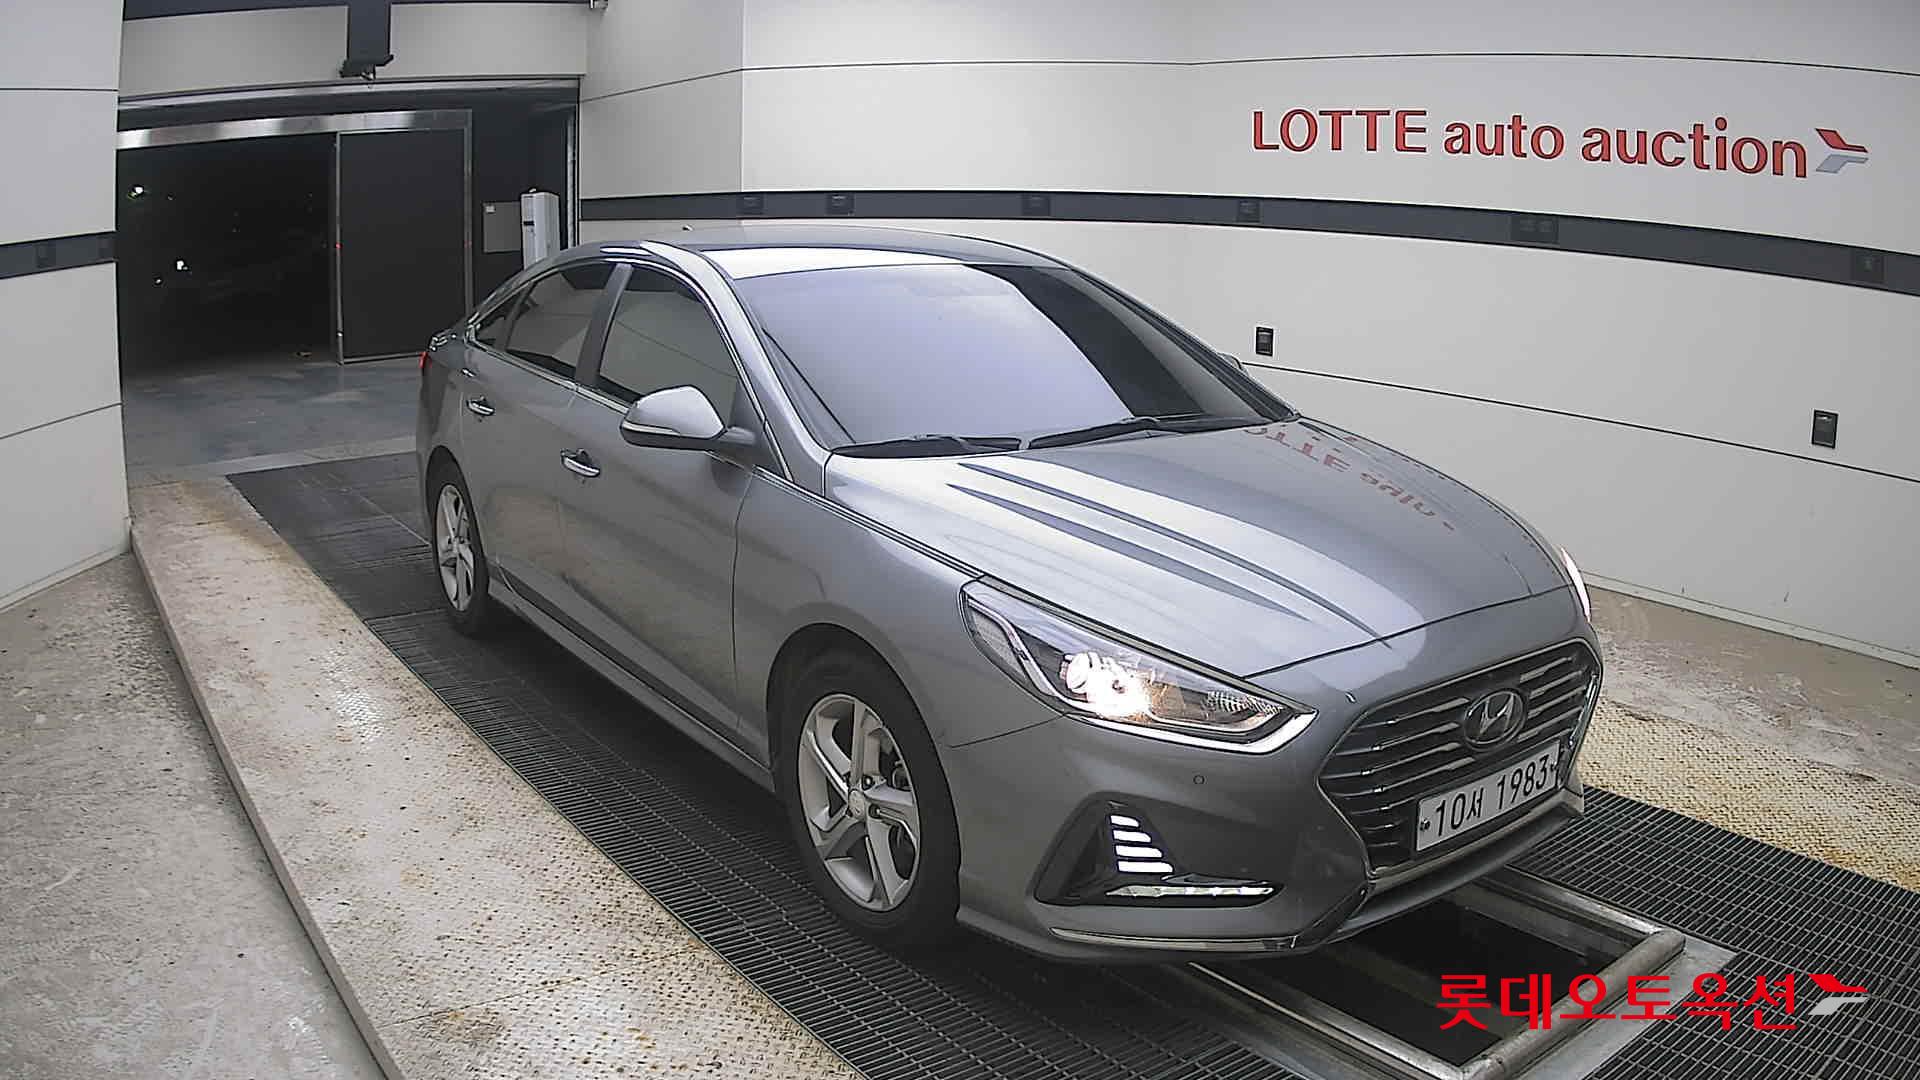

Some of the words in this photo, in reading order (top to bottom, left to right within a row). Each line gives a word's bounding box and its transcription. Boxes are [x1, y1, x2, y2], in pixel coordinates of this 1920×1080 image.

[1251, 109, 1428, 153] LOTTE
[1442, 114, 1566, 160] auto
[1581, 117, 1808, 178] auction
[1435, 786, 1485, 837] 10서
[1496, 753, 1550, 810] 1983
